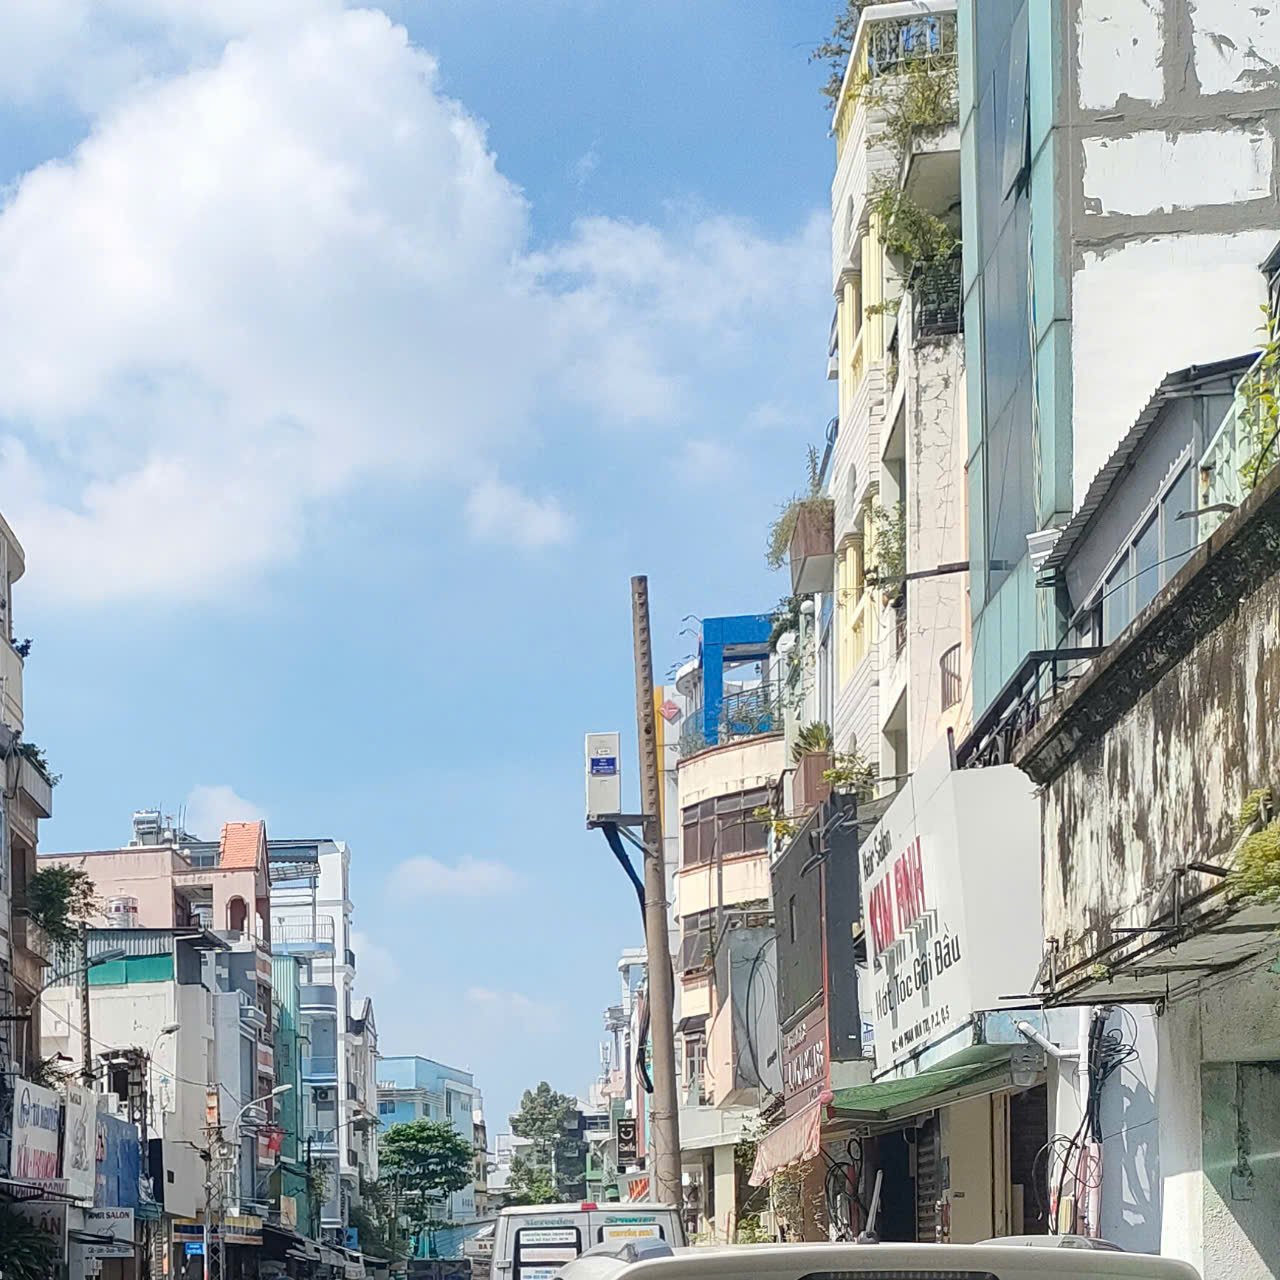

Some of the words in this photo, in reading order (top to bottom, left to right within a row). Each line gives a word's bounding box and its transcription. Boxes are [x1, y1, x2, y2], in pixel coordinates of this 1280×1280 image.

[875, 828, 893, 867] Salon
[893, 969, 913, 1005] Tóc
[934, 921, 961, 976] Đầu
